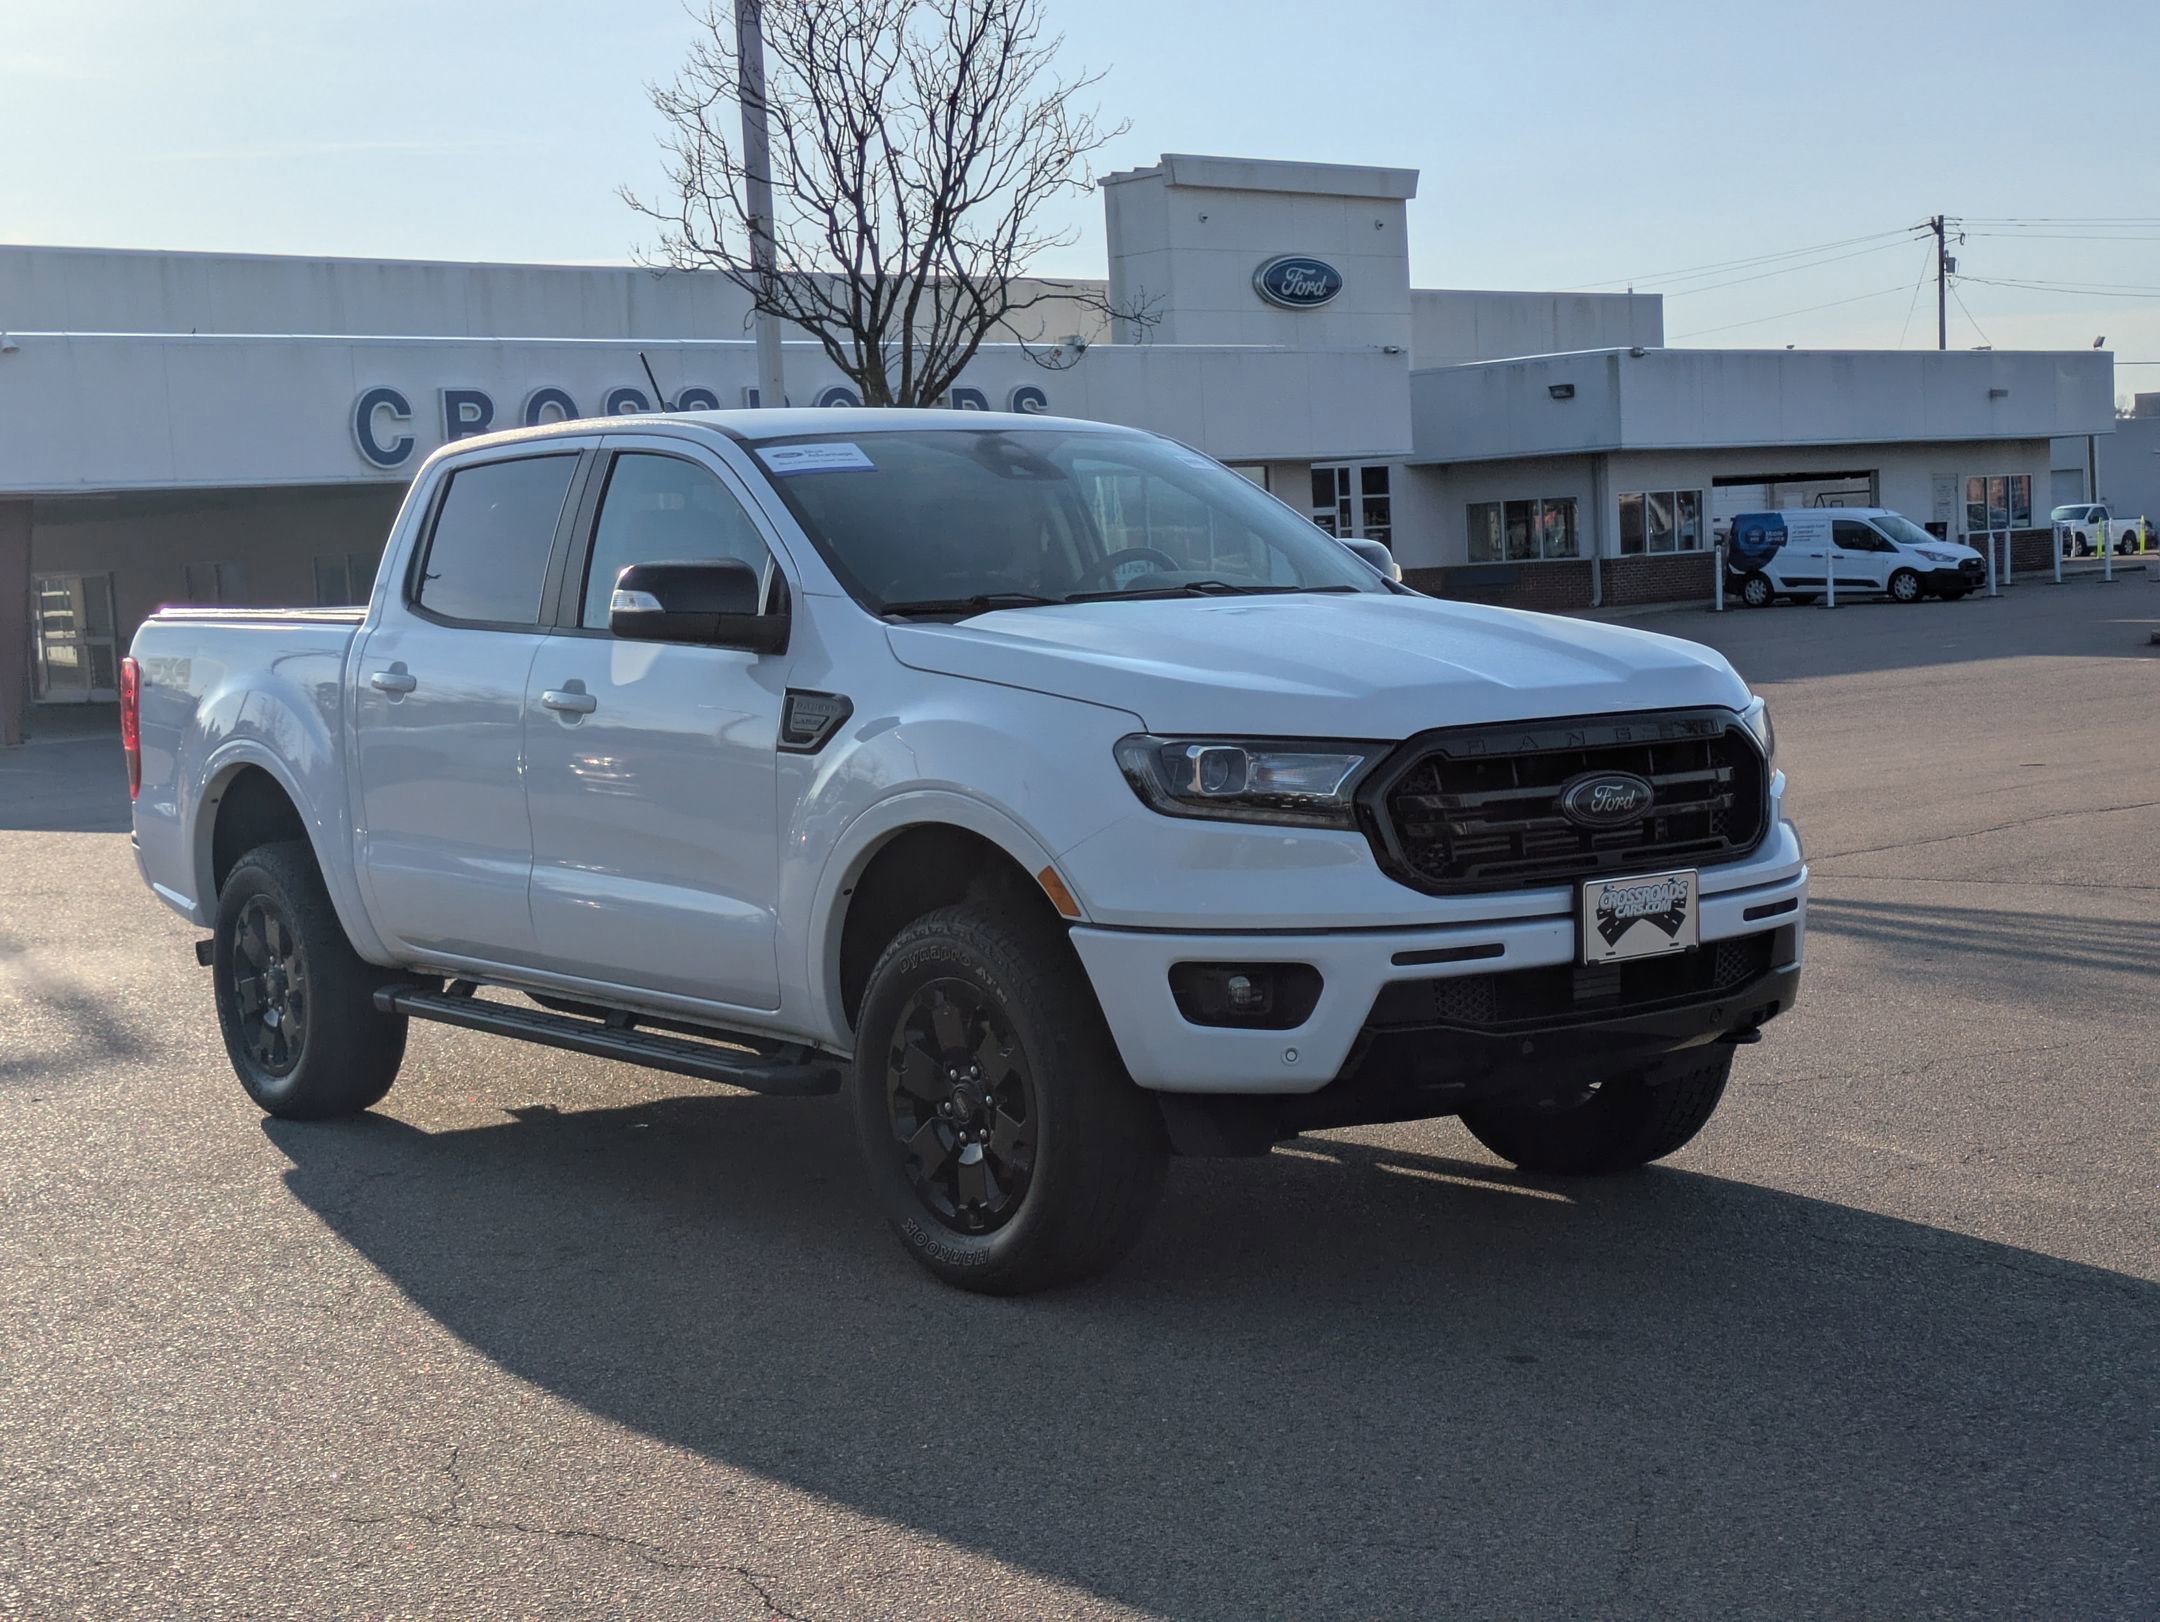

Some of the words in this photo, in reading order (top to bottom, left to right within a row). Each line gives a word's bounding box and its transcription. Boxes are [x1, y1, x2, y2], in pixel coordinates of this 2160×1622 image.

[1281, 267, 1327, 296] Ford
[144, 657, 192, 683] FX4
[1591, 785, 1635, 812] Ford
[1599, 880, 1689, 910] CROSSROADS
[1615, 899, 1672, 919] CARS.COM
